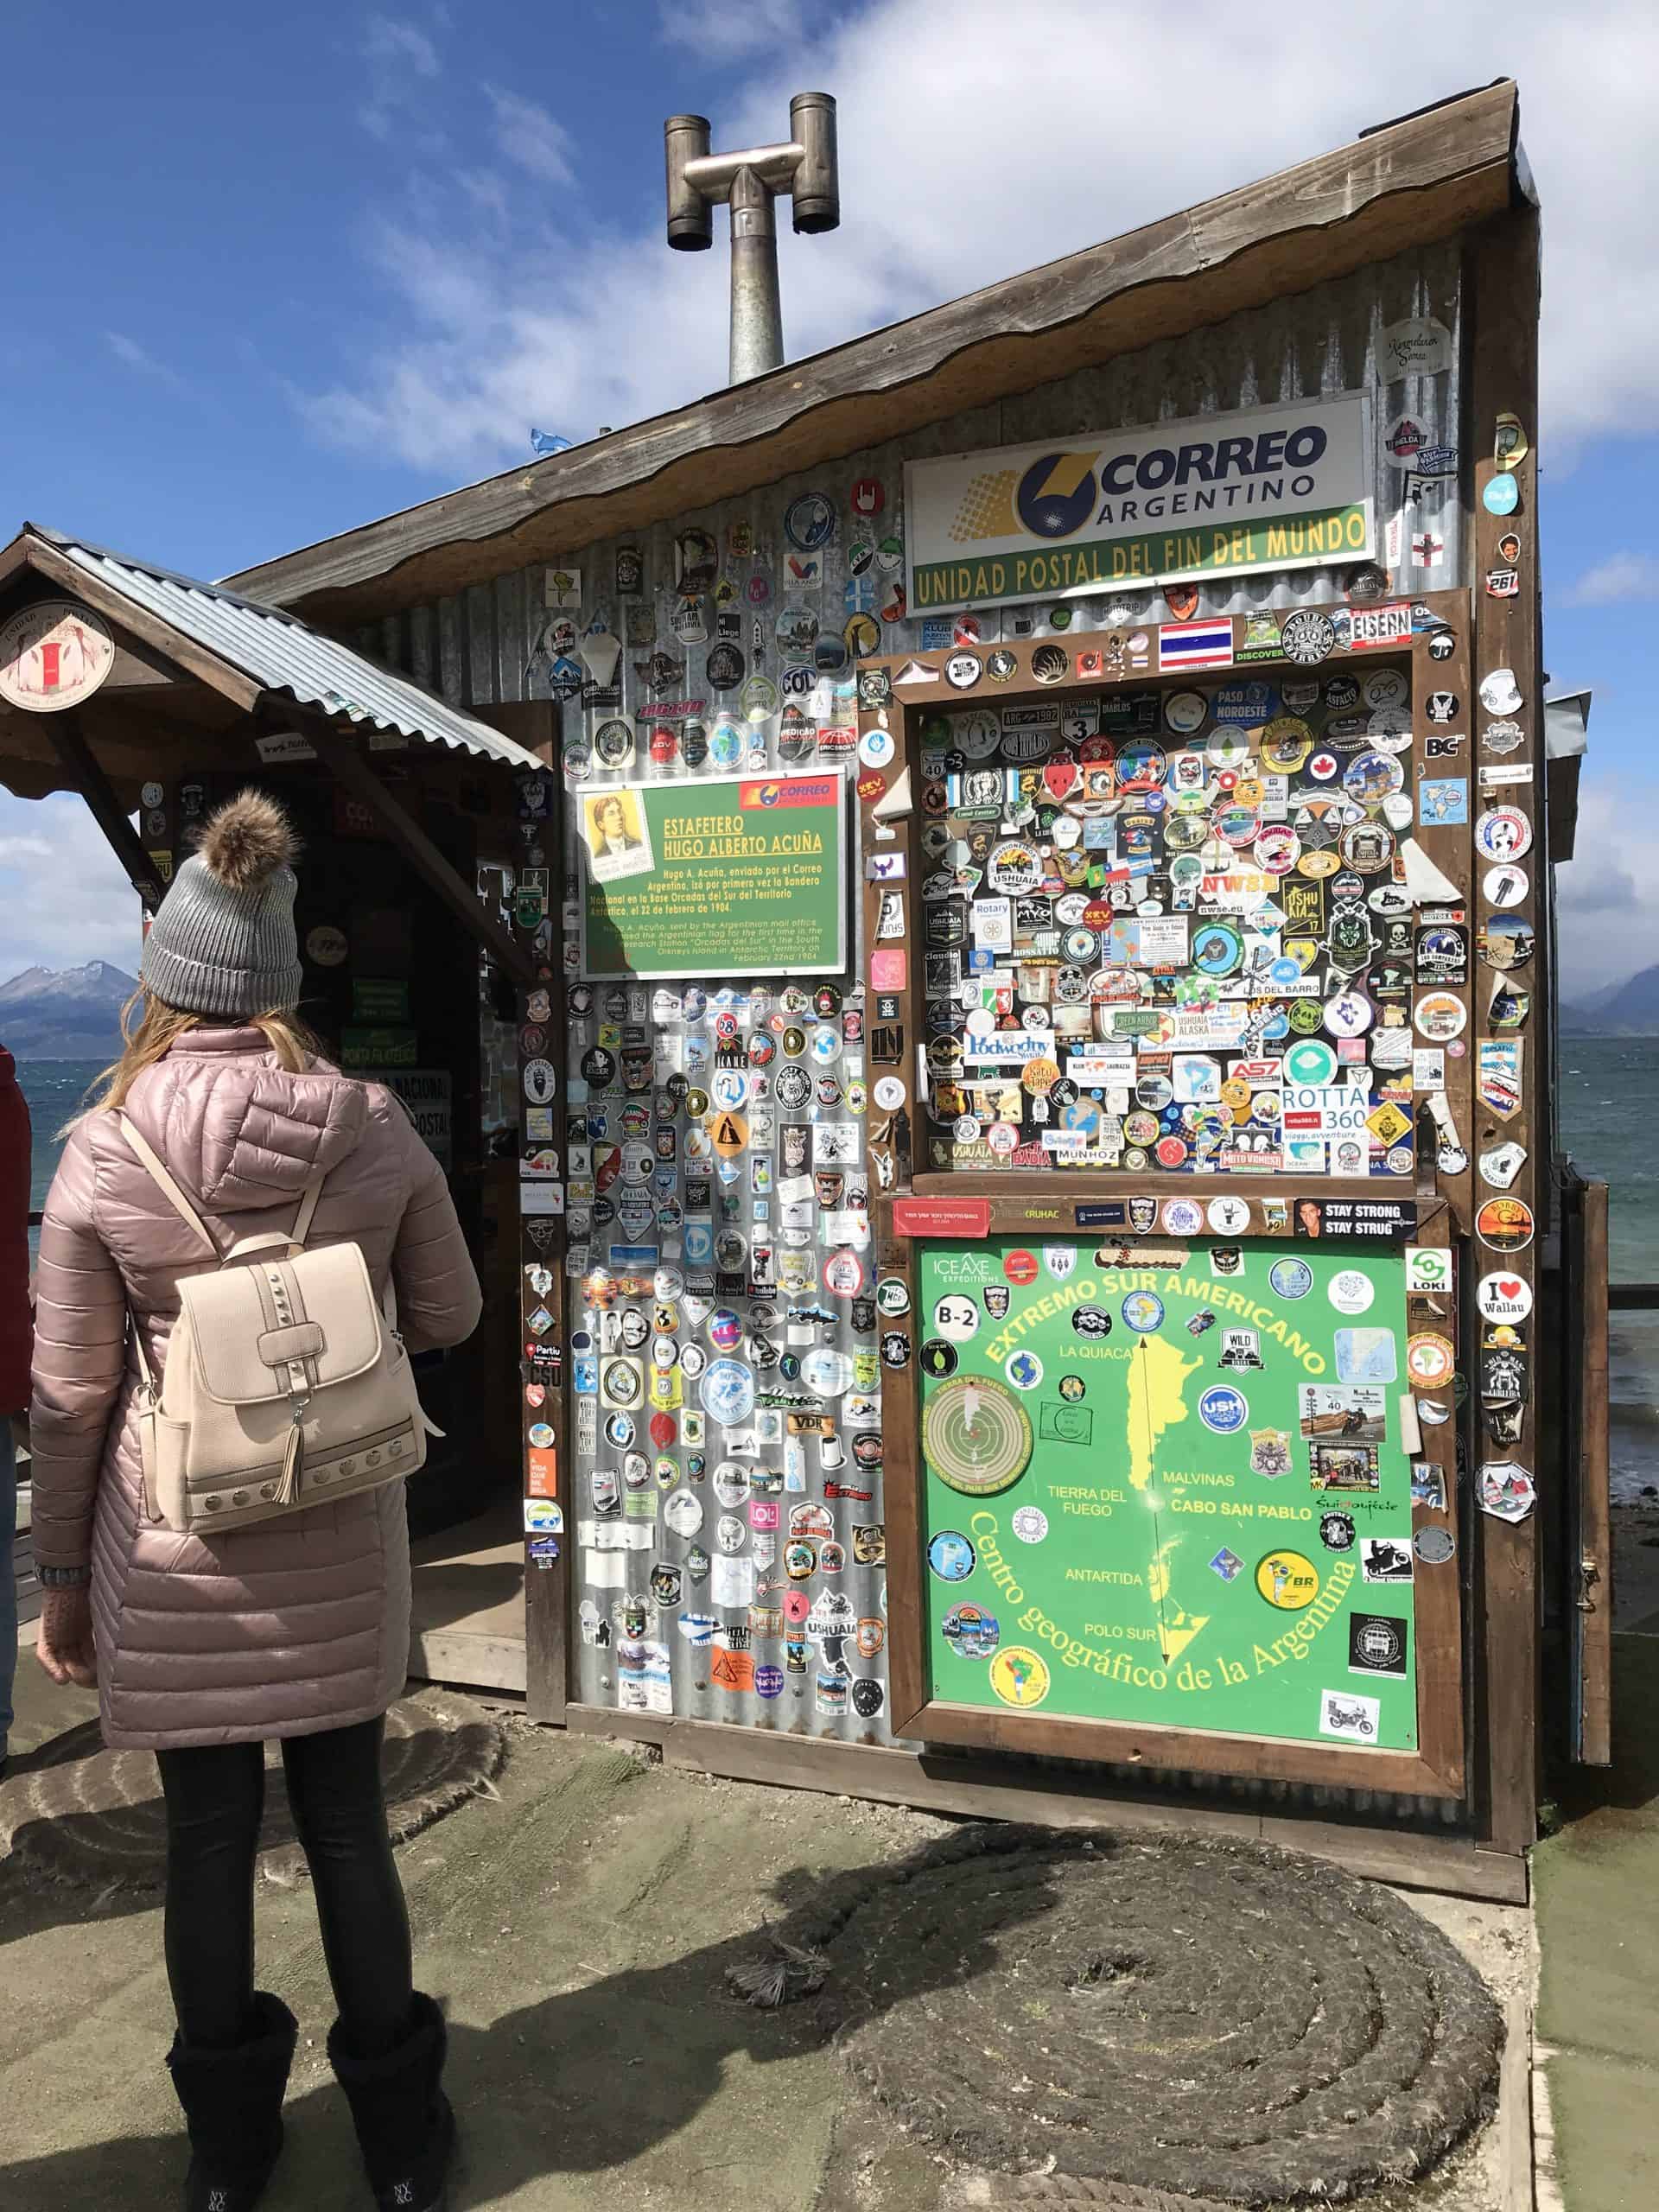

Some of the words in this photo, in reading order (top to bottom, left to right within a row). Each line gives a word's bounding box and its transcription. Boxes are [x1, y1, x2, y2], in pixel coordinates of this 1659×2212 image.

[1101, 425, 1327, 495] CORREO
[1096, 475, 1315, 525] ARGENTINO
[918, 563, 1005, 603] UNIDAD
[1017, 550, 1103, 591] POSTAL
[1112, 543, 1153, 578] DEL
[1164, 535, 1202, 571] FIN
[1214, 529, 1256, 565] DEL
[1268, 512, 1365, 557] MUNDO
[1353, 611, 1410, 638] EISERN
[1236, 649, 1283, 660] DISCOVER
[1217, 690, 1243, 702] PASO
[1217, 706, 1267, 718] NOROESTE
[1072, 721, 1087, 738] 3
[925, 765, 942, 775] 40
[779, 785, 830, 796] CORREO
[664, 816, 743, 836] ESTAFETERO
[664, 839, 703, 858] HUGO
[709, 836, 766, 855] ALBERTO
[772, 830, 823, 852] ACUÑA
[664, 870, 683, 880] Hugo
[729, 867, 763, 875] enviado
[766, 867, 779, 876] por
[782, 864, 791, 874] el
[793, 864, 822, 874] Correo
[706, 881, 719, 891] por
[722, 879, 753, 889] primera
[773, 877, 782, 886] la
[785, 876, 820, 886] Bandera
[994, 874, 1039, 886] USHUAIA
[1203, 875, 1278, 893] NWSE
[639, 894, 648, 904] la
[671, 893, 705, 902] Orcadas
[709, 892, 721, 900] del
[724, 891, 735, 900] Sur
[739, 890, 752, 899] del
[755, 889, 791, 899] Territorio
[1288, 891, 1319, 906] USHU
[641, 906, 650, 914] 22
[653, 905, 663, 913] de
[665, 904, 694, 913] febrero
[698, 904, 707, 912] de
[976, 904, 1008, 914] Rotary
[1200, 905, 1243, 913] nwse.eu
[930, 917, 961, 925] USHUAIA
[1310, 920, 1319, 931] 17
[925, 951, 958, 960] Claudio
[1243, 985, 1262, 994] LOS
[1285, 984, 1319, 993] BARRO
[1179, 1015, 1208, 1025] USHUAIA
[1179, 1026, 1210, 1035] ALASKA
[1231, 1060, 1281, 1077] A57
[1282, 1087, 1365, 1109] ROTTA
[1326, 1109, 1365, 1129] 360
[1059, 1149, 1117, 1160] MUNHOZ
[1326, 1205, 1353, 1217] STAY
[1356, 1205, 1401, 1218] STRONG
[1326, 1222, 1353, 1234] STAY
[1356, 1223, 1393, 1235] STRUG
[934, 1260, 959, 1274] ICE
[962, 1254, 989, 1276] AXE
[943, 1274, 999, 1284] EXPEDITIONS
[1488, 1282, 1499, 1301] I
[1484, 1302, 1525, 1313] Wallau
[938, 1306, 975, 1326] B-2
[985, 1279, 1097, 1365] EXTREMO
[1105, 1272, 1157, 1295] SUR
[1166, 1275, 1325, 1376] AMERICANO
[1230, 1335, 1251, 1348] WILD
[537, 1345, 561, 1356] Partiu
[1059, 1345, 1077, 1357] LA
[1081, 1347, 1134, 1360] QUIACA
[1205, 1401, 1243, 1412] USH
[1163, 1471, 1235, 1486] MALVINAS
[1047, 1485, 1097, 1500] TIERRA
[1101, 1489, 1127, 1502] DEL
[1064, 1503, 1112, 1516] FUEGO
[1171, 1499, 1216, 1514] CABO
[1221, 1503, 1253, 1516] SAN
[1258, 1505, 1313, 1520] PABLO
[1065, 1568, 1143, 1586] ANTARTIDA
[1294, 1577, 1314, 1586] BR
[970, 1511, 1024, 1604] Centro
[1017, 1606, 1167, 1690] geográfico
[1177, 1662, 1212, 1692] de
[1217, 1656, 1249, 1686] la
[1253, 1559, 1356, 1675] Argentina
[808, 1624, 858, 1636] USHUAIA
[1084, 1624, 1122, 1637] POLO
[1127, 1628, 1156, 1641] SUR
